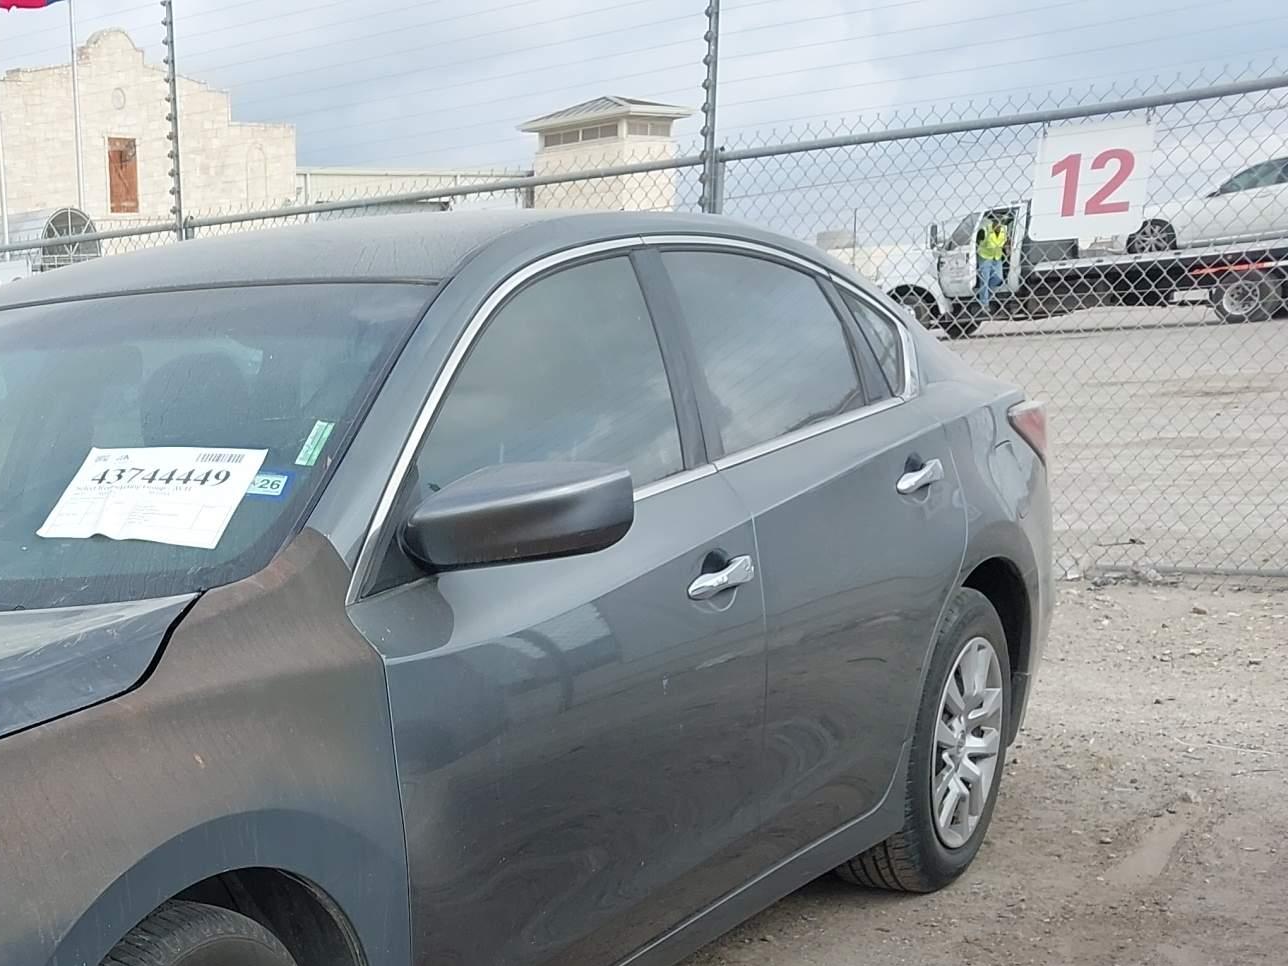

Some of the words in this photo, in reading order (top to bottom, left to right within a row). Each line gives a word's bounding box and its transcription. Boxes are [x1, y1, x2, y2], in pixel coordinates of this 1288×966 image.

[1052, 149, 1135, 217] 12
[91, 467, 231, 486] 43744449
[258, 479, 282, 490] 26
